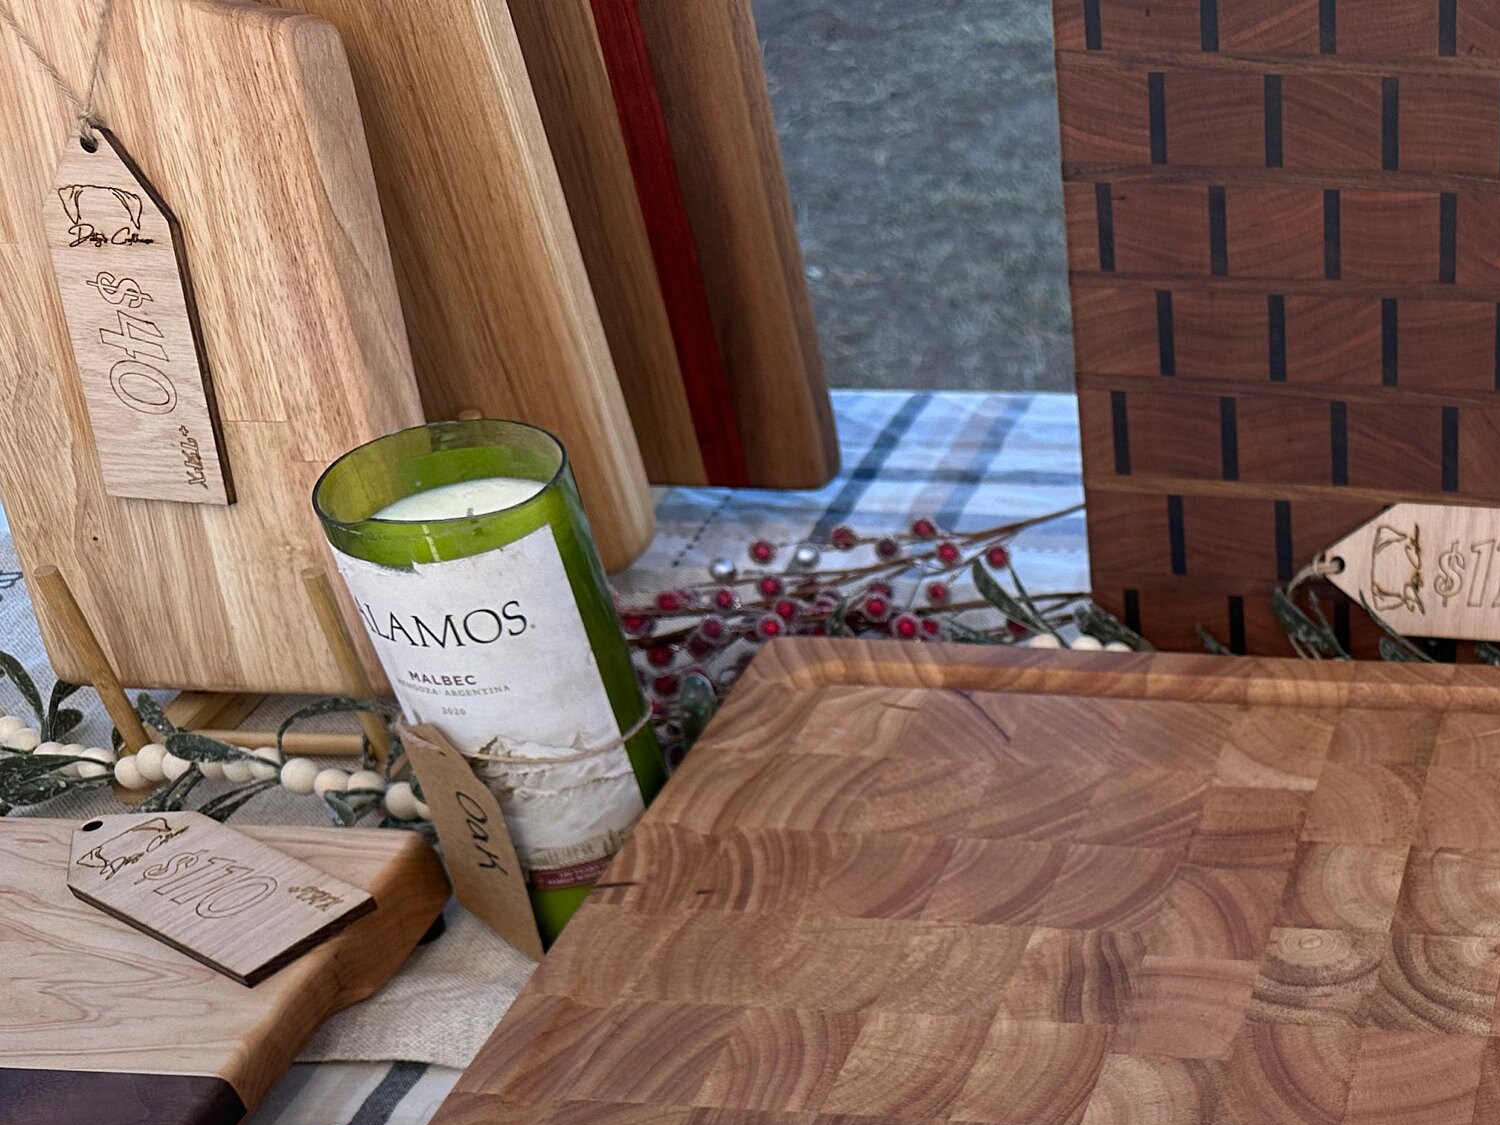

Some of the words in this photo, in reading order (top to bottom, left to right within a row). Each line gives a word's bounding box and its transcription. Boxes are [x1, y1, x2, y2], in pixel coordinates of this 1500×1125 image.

[86, 270, 178, 415] $40
[408, 671, 477, 686] MALBEC
[444, 684, 511, 697] ARGENTINA
[456, 791, 508, 876] Oak
[134, 849, 279, 918] $110
